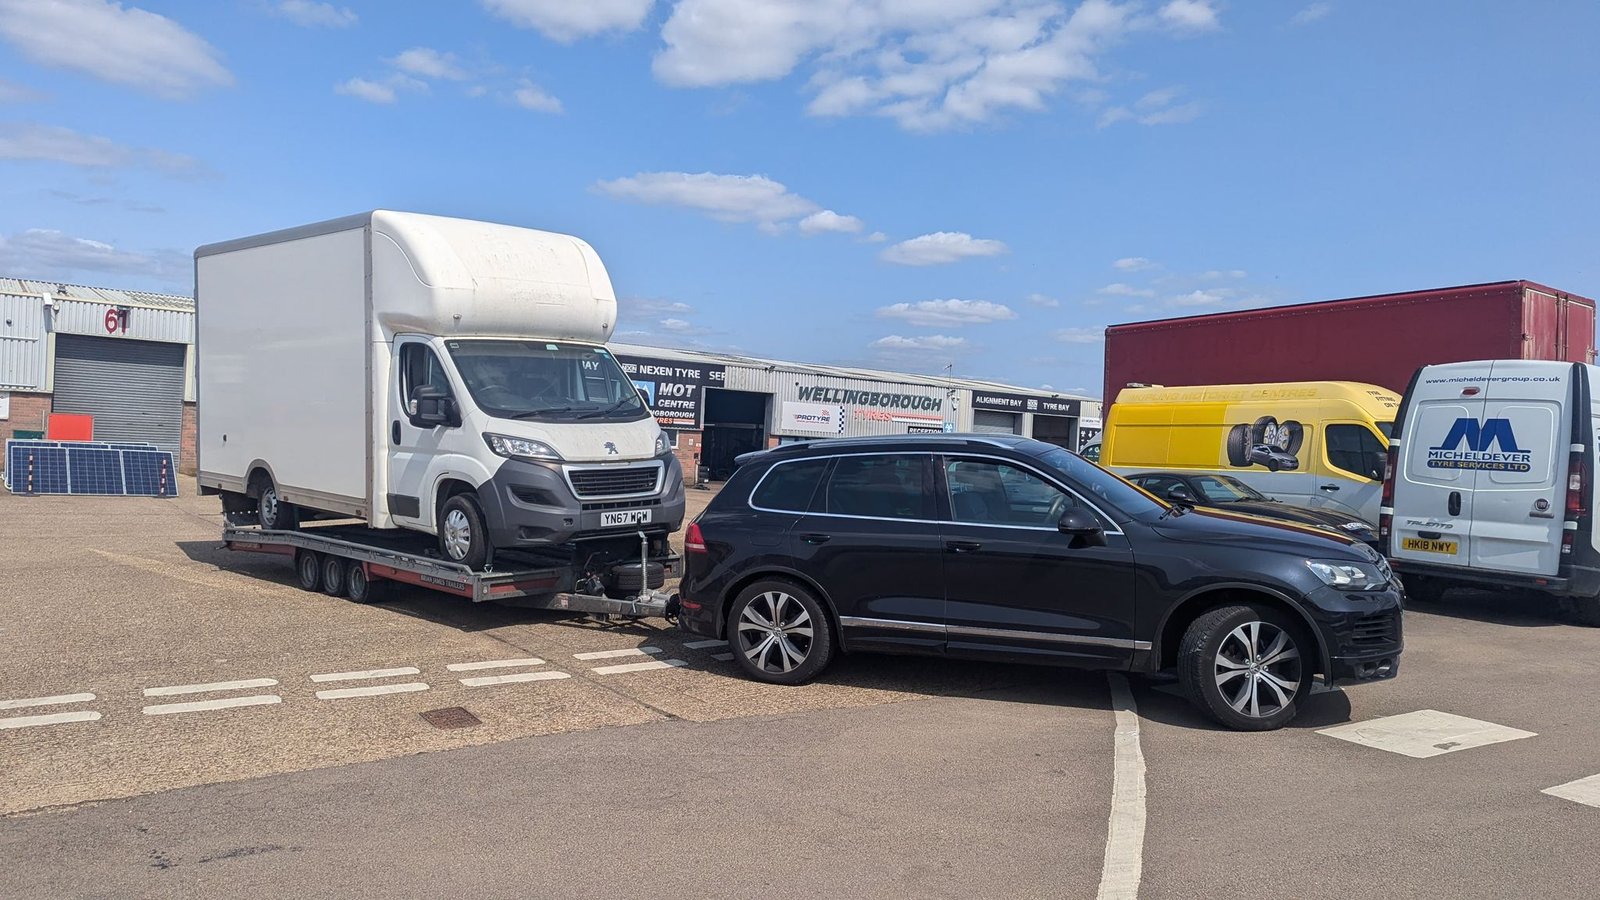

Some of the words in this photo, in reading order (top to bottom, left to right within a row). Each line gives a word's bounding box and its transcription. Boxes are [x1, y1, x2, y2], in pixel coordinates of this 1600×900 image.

[105, 309, 127, 334] 61
[640, 364, 673, 376] NEXEN
[675, 368, 701, 379] TYRE
[1425, 376, 1561, 384] www.micheldevergroup.co.uk
[659, 382, 696, 397] MOT
[658, 399, 695, 409] CENTRE
[798, 386, 942, 412] WELLINGBOROUGH
[975, 396, 1009, 406] ALIGNMENT
[1010, 399, 1022, 407] BAY
[1043, 402, 1058, 410] TYRE
[795, 414, 831, 422] PROTYRE
[854, 409, 892, 422] TYRES
[1428, 451, 1530, 462] MICHELDEVER
[1430, 460, 1458, 468] TYRE
[1458, 461, 1505, 470] SERVICES
[1507, 463, 1529, 471] LTD
[604, 512, 628, 524] YN67
[1407, 539, 1429, 550] HK18
[1431, 541, 1451, 553] NWY
